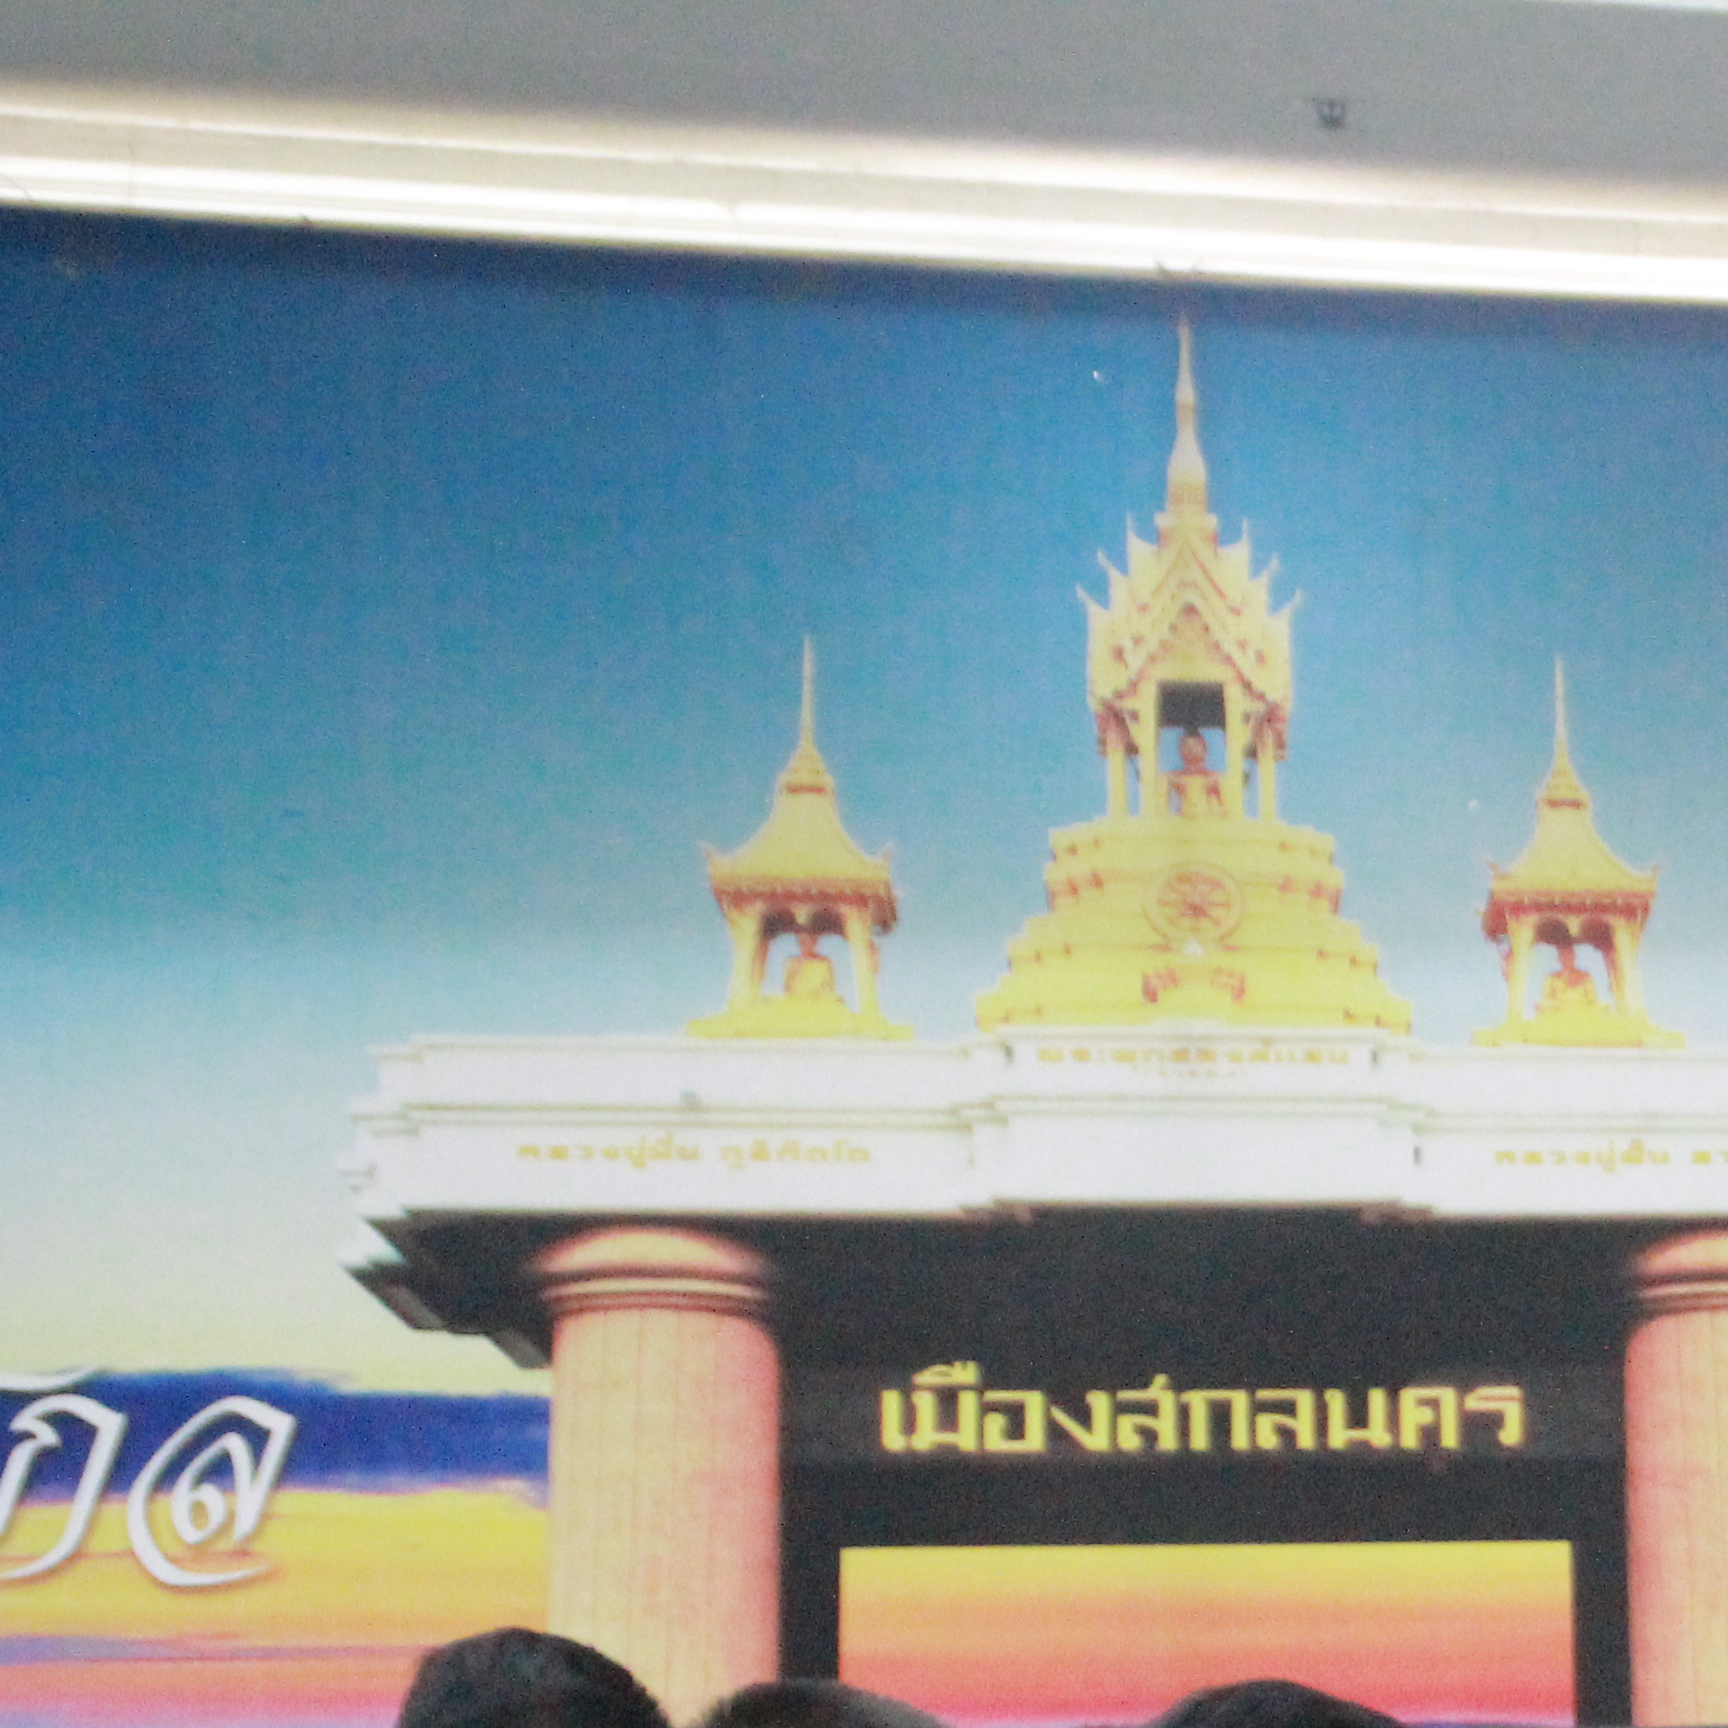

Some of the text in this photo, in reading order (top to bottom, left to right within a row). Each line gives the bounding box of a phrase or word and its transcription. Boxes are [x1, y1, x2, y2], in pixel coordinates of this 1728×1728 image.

[0, 1367, 297, 1588] กล
[879, 1360, 1524, 1452] เมืองสกลนคร
